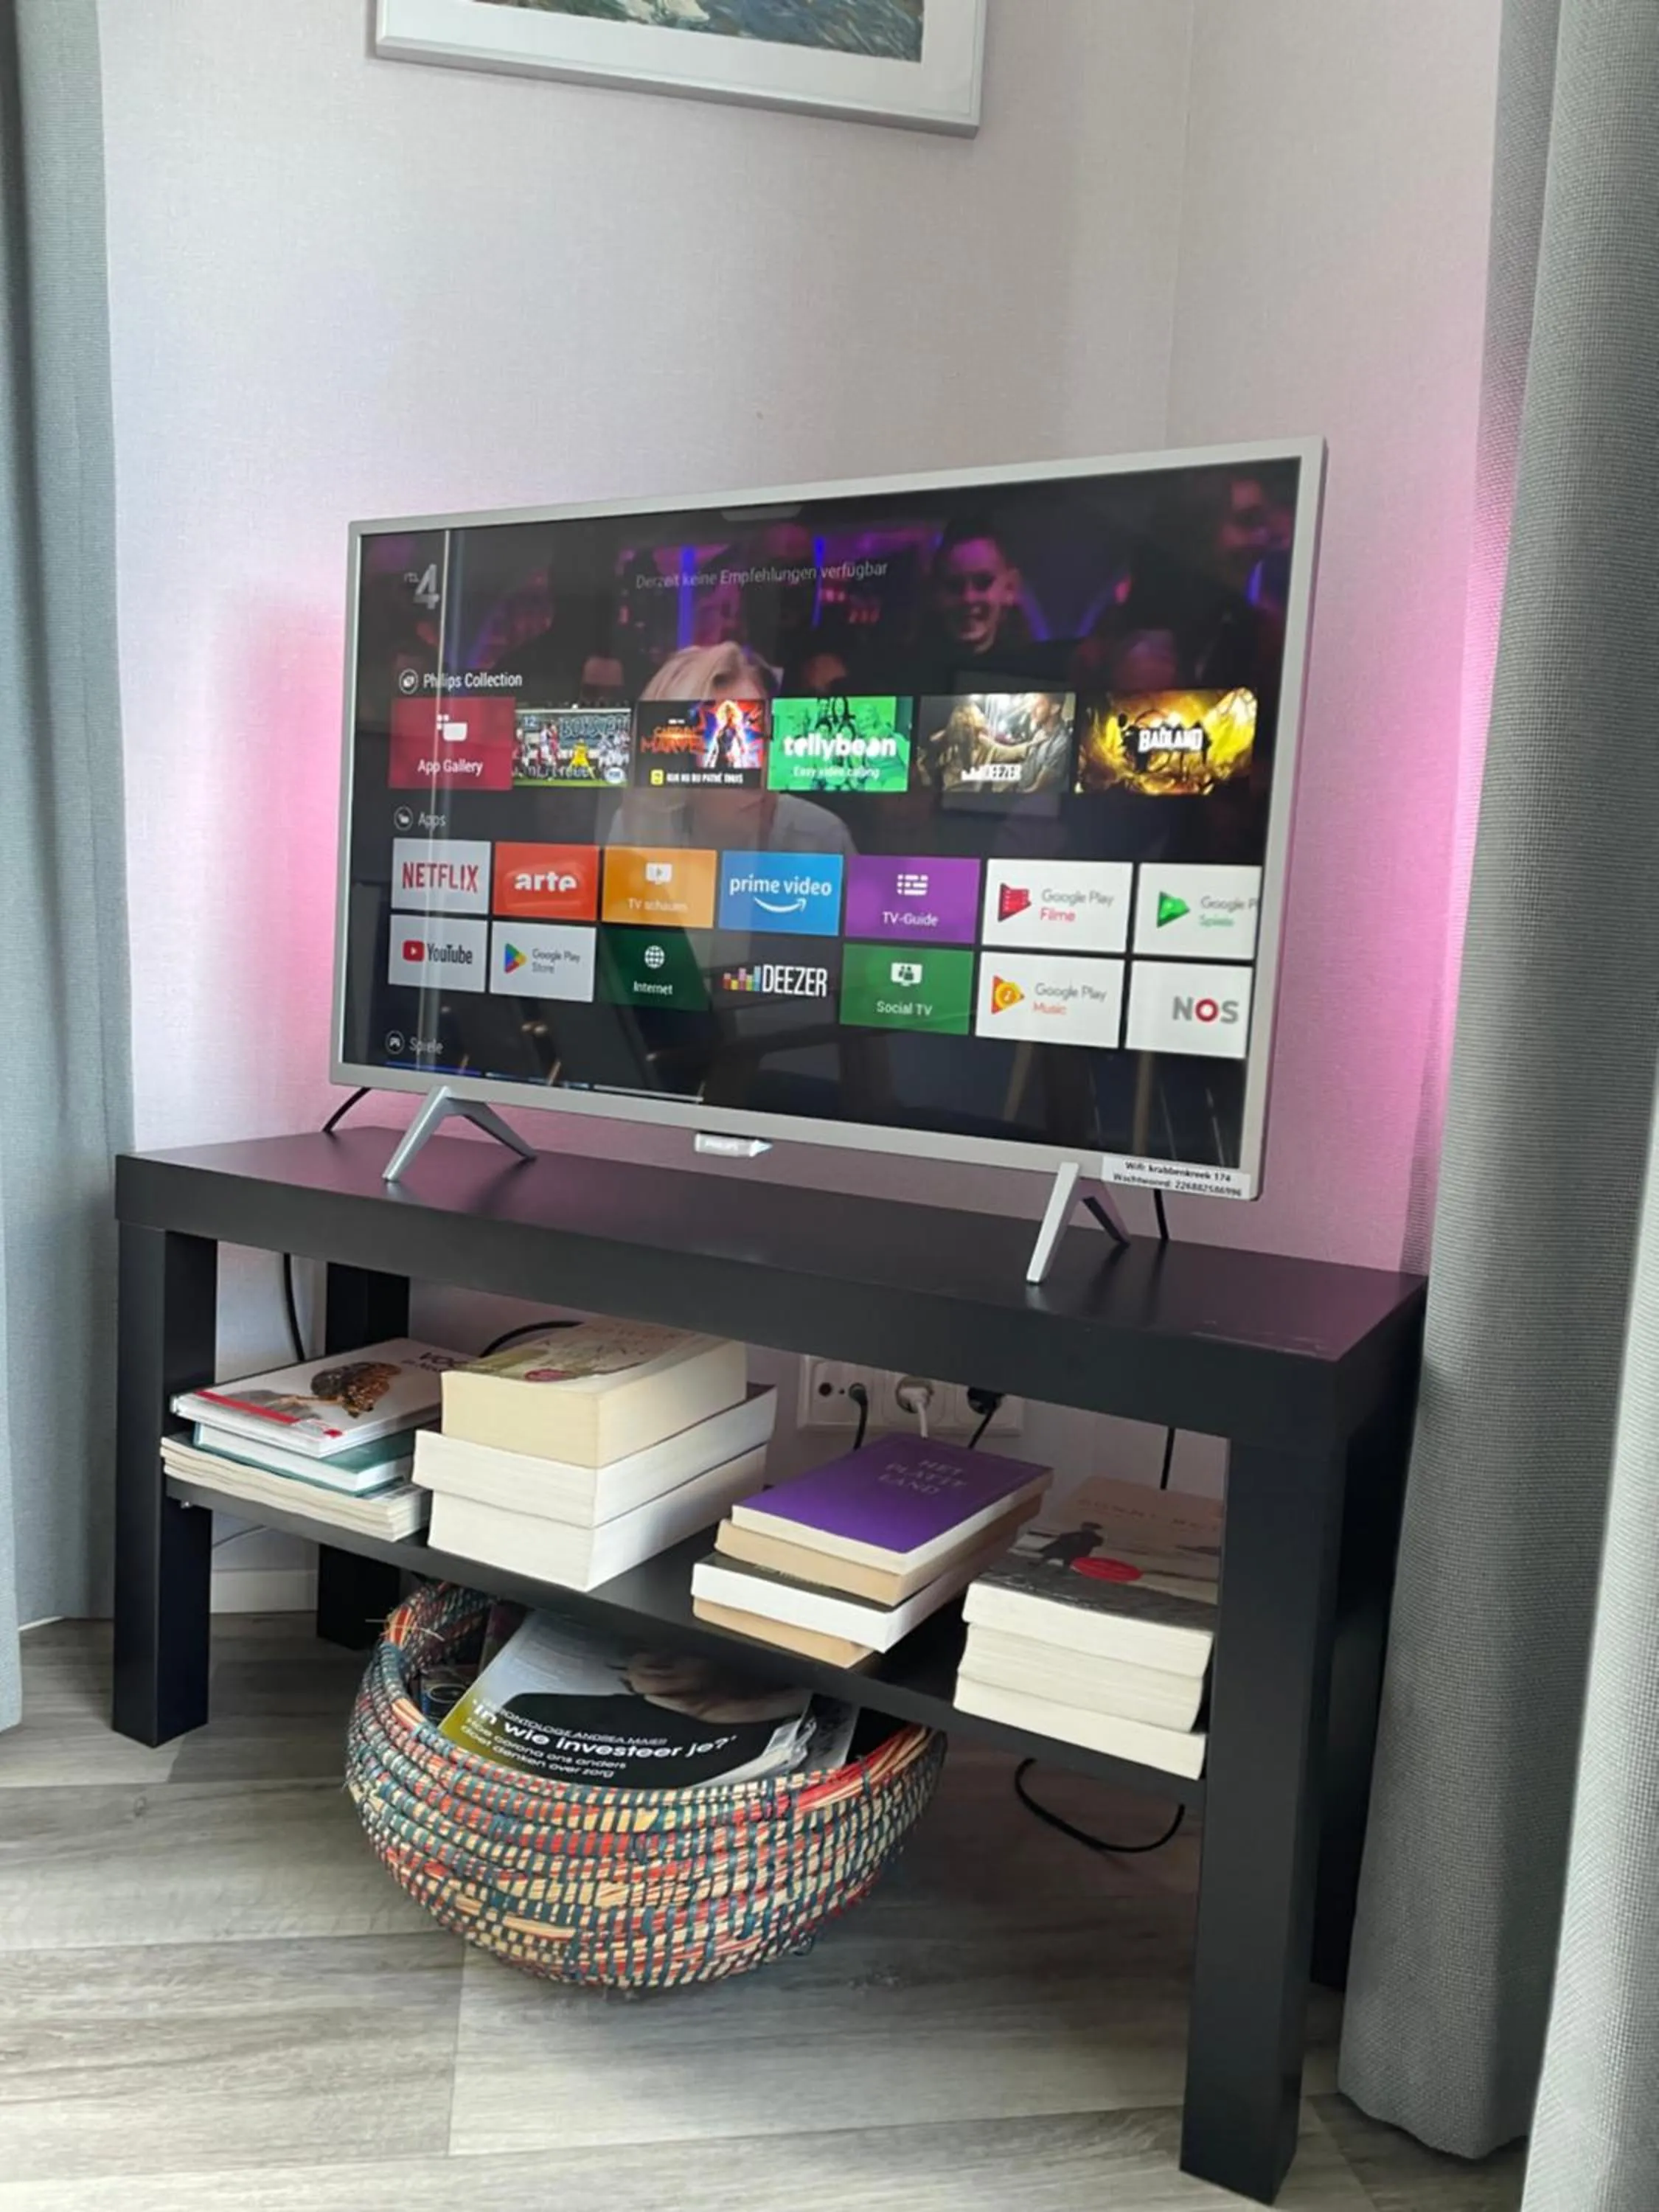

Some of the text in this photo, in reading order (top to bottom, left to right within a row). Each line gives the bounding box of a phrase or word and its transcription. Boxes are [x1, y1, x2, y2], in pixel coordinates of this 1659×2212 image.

[636, 561, 888, 589] Derzeit keine Empfehlungen verfügbar
[413, 563, 440, 610] 4
[423, 672, 523, 691] Philips Collection
[783, 732, 897, 761] tellybean
[1138, 727, 1203, 753] BADLAND
[417, 759, 484, 776] App Gallery
[418, 812, 447, 829] Apps
[402, 861, 479, 893] NETFLIX
[514, 870, 578, 892] arte
[729, 874, 832, 896] prime video
[1041, 888, 1114, 908] Google Play
[1200, 894, 1245, 914] Google
[882, 911, 939, 928] TV-Guide
[1040, 908, 1077, 923] Filme
[426, 941, 473, 964] YouTube
[532, 948, 581, 964] Google Play
[532, 961, 554, 974] Store
[633, 981, 673, 995] Internet
[762, 963, 828, 997] DEEZER
[1034, 981, 1107, 1002] Google Play
[876, 1000, 933, 1016] Social TV
[1032, 1001, 1067, 1015] Music
[1172, 995, 1239, 1024] NOS
[1214, 1172, 1231, 1182] 174
[504, 1721, 551, 1745] wie
[555, 1736, 684, 1759] investeer
[492, 1745, 547, 1768] denken
[548, 1763, 581, 1774] over
[581, 1768, 615, 1779] zorg
[493, 1734, 545, 1759] corona
[546, 1752, 573, 1765] ons
[574, 1755, 627, 1770] anders
